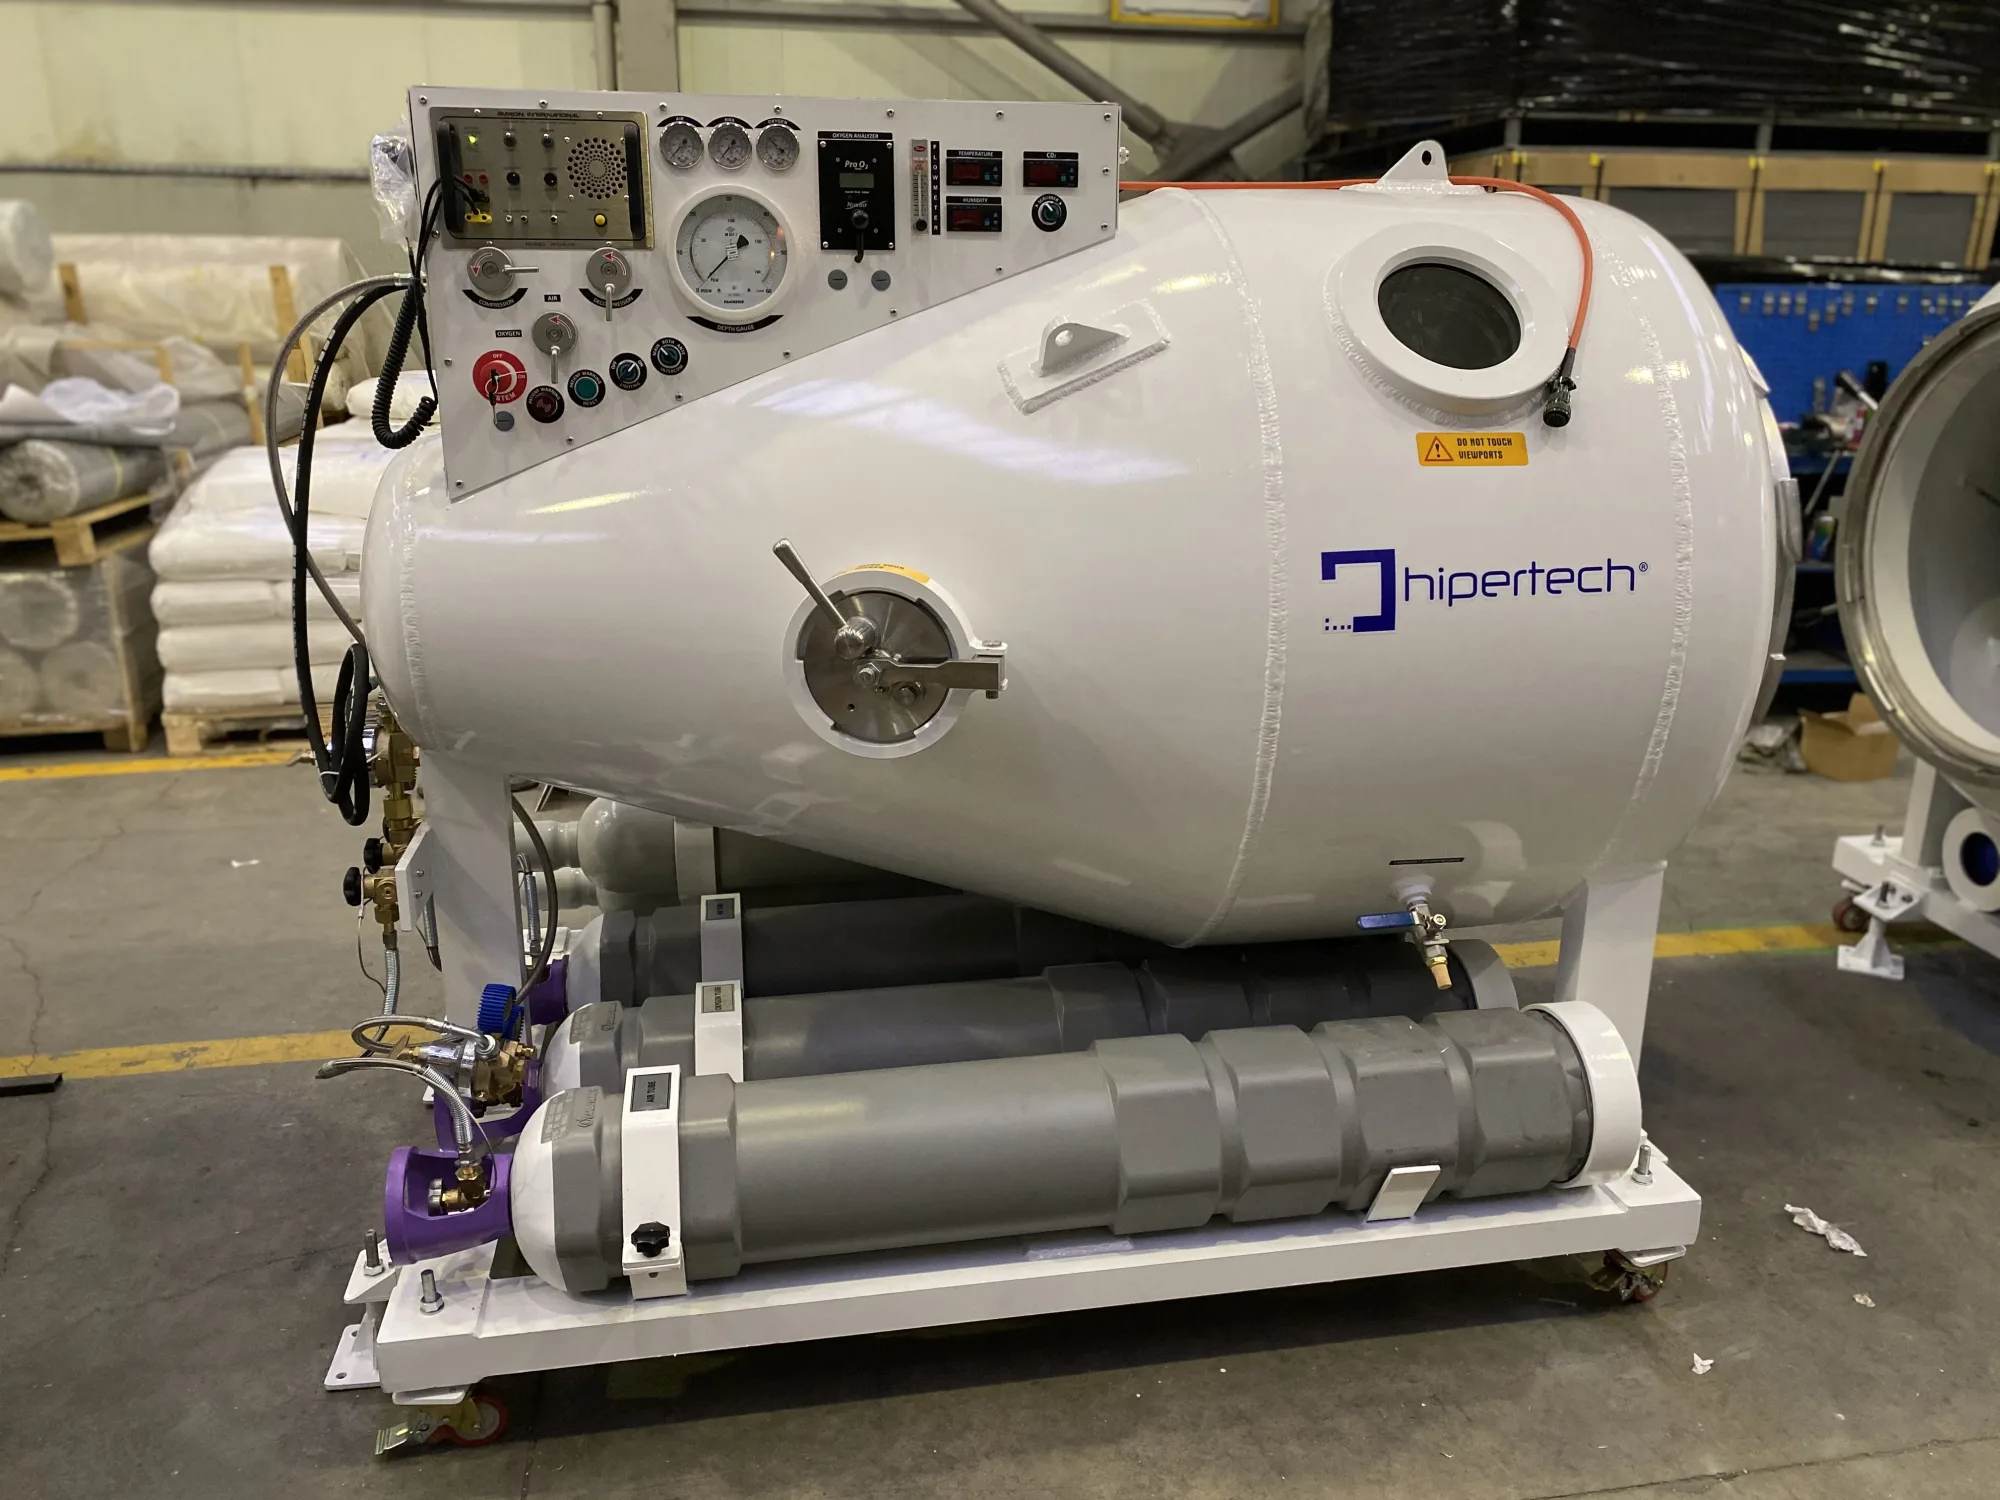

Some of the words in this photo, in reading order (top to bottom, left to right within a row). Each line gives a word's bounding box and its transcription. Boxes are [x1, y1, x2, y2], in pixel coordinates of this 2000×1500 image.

[844, 160, 858, 168] Pro
[478, 299, 515, 308] COMPRESSION
[716, 324, 736, 332] DEPTH
[652, 344, 660, 356] MAIN
[660, 364, 684, 373] INTERCOM
[569, 373, 581, 388] PATIENT
[582, 372, 602, 385] WARNING
[529, 388, 540, 405] PATIENT
[540, 387, 561, 400] WARNING
[1456, 438, 1468, 446] DO
[1470, 438, 1484, 446] NOT
[1486, 438, 1512, 446] TOUCH
[1458, 450, 1503, 459] VIEWPORTS
[646, 1081, 656, 1094] TUBE
[646, 1094, 655, 1102] AIR
